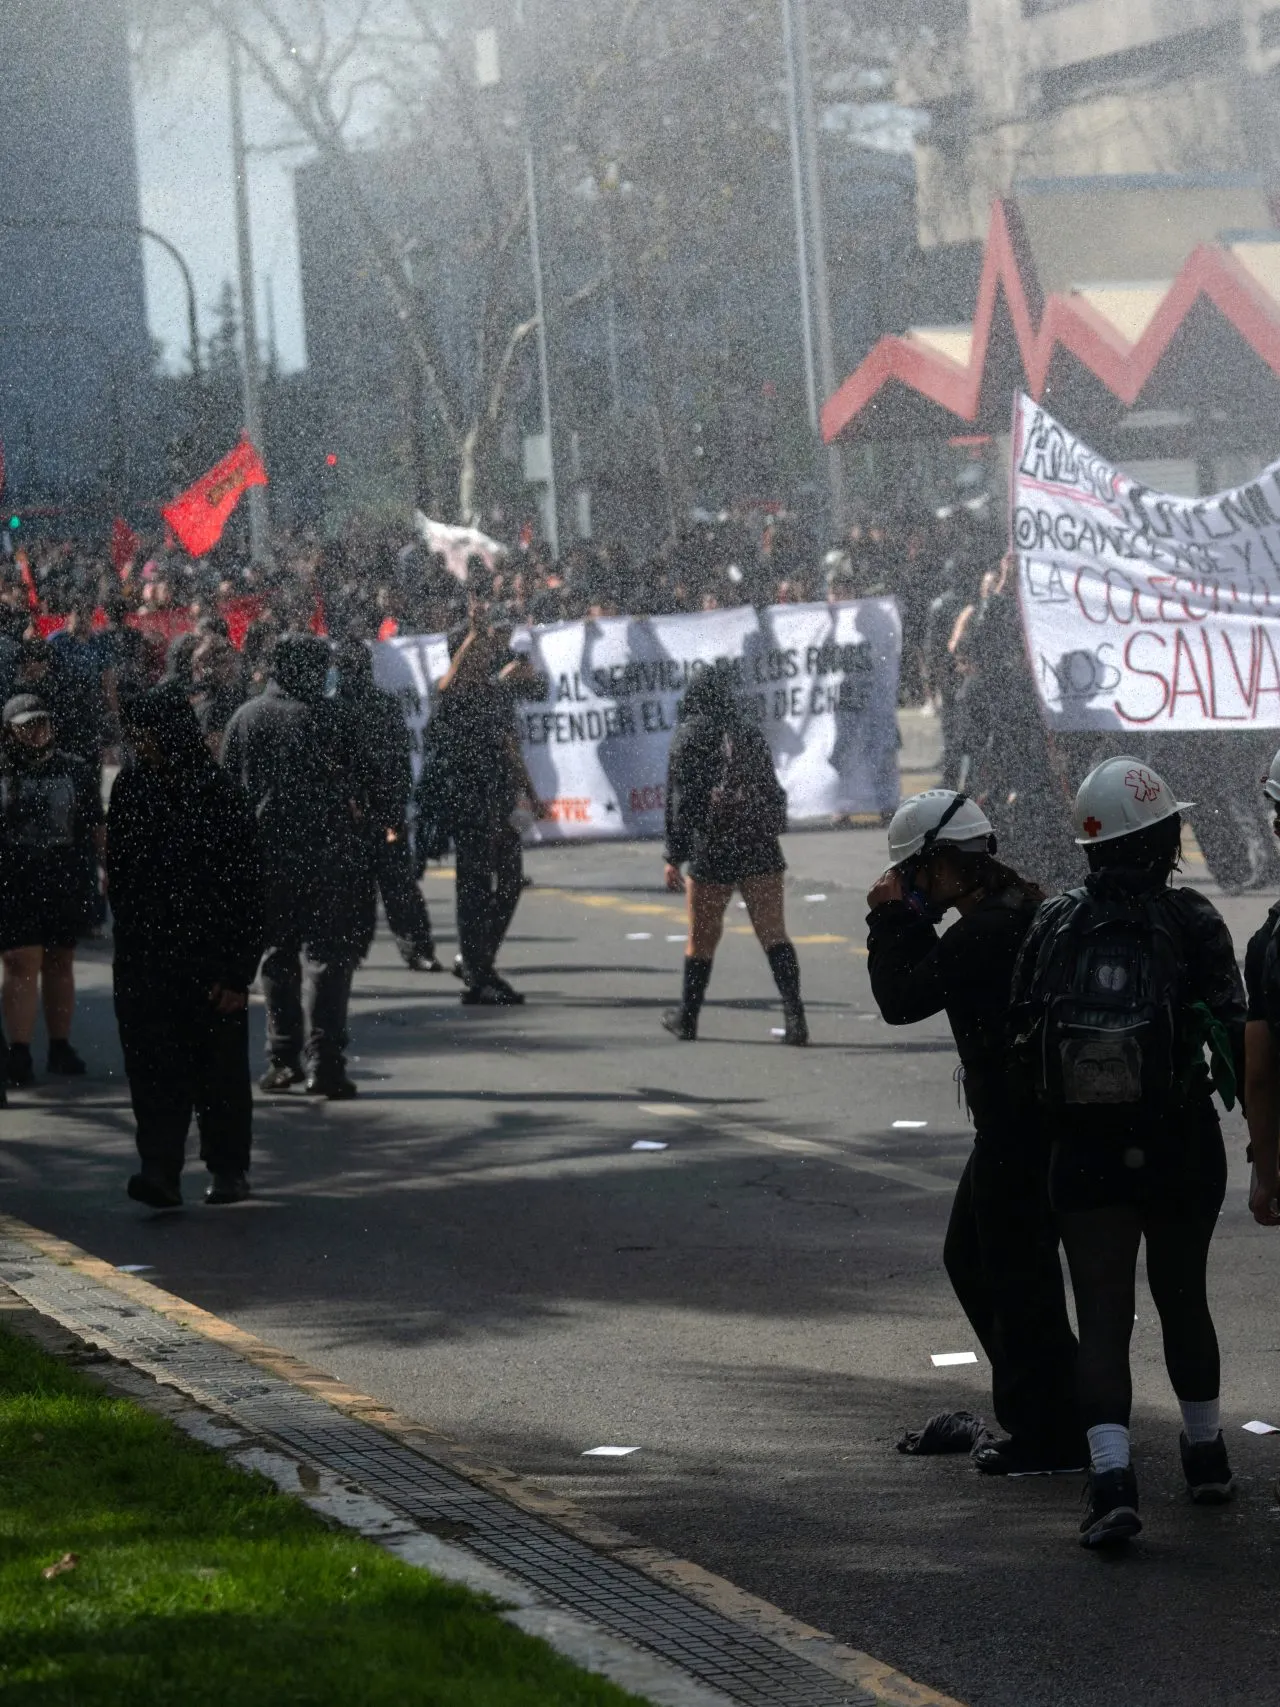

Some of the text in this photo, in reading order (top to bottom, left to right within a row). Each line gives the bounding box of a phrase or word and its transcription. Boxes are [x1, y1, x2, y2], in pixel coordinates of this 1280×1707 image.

[1232, 540, 1252, 574] Y
[1026, 557, 1072, 601] LA
[1041, 642, 1121, 693] NOS
[558, 672, 588, 702] AL
[640, 700, 671, 733] EL
